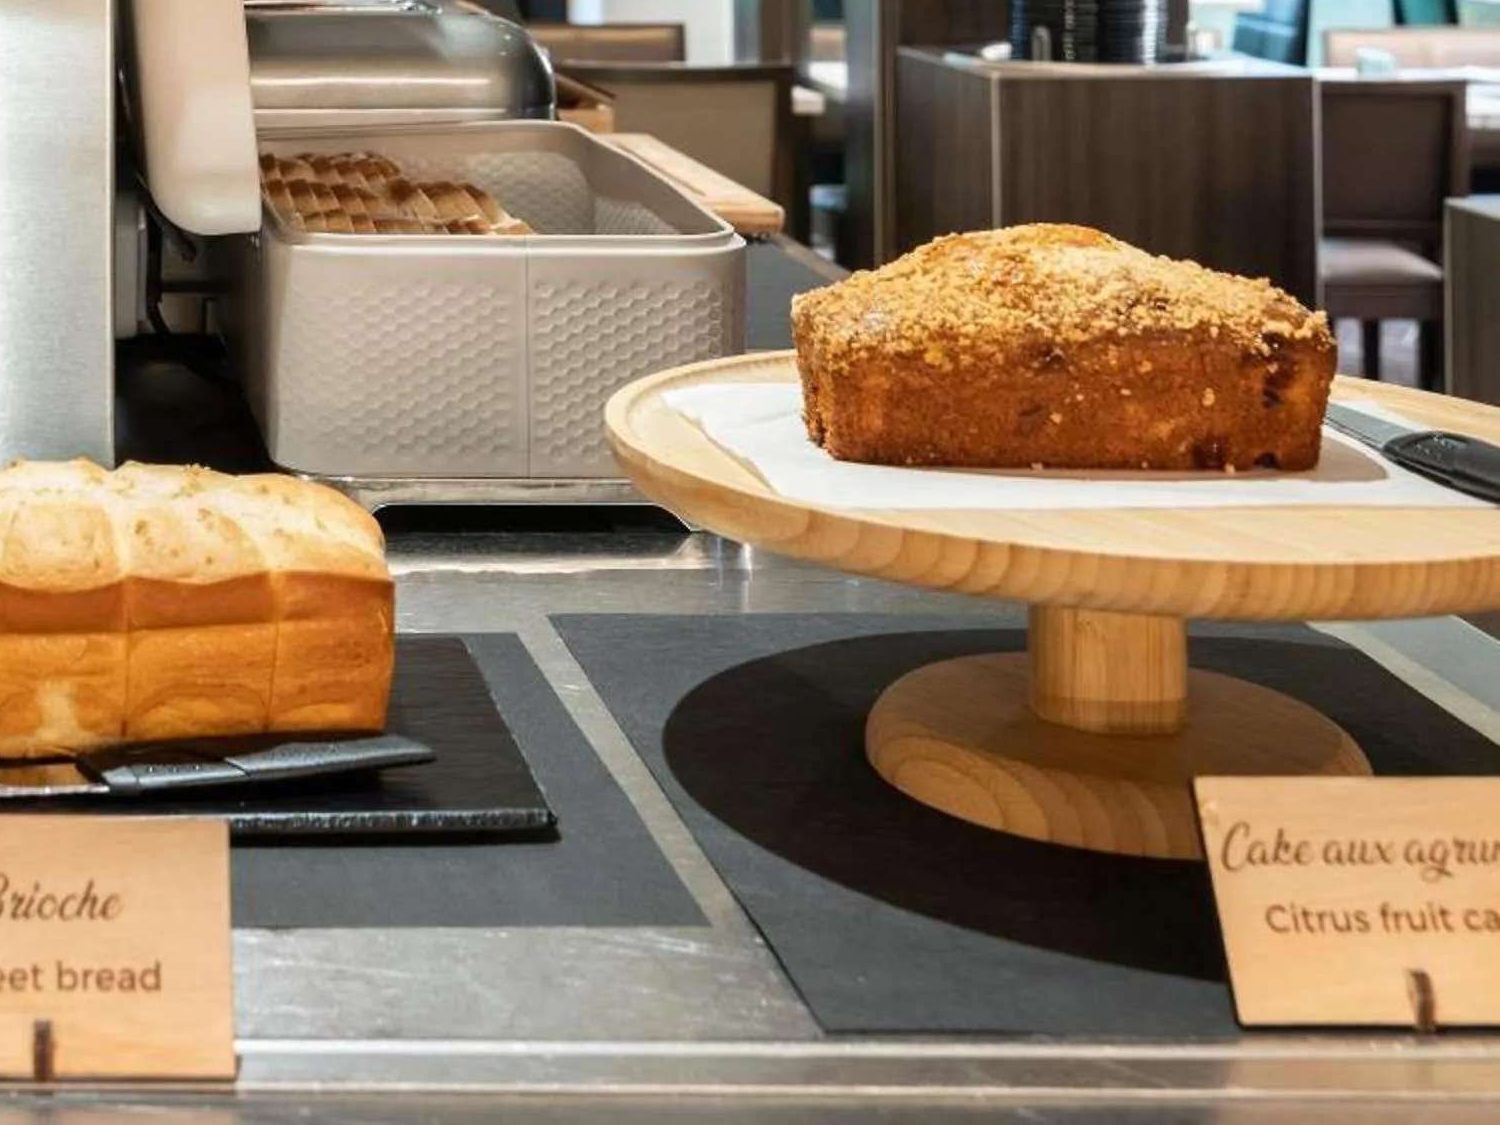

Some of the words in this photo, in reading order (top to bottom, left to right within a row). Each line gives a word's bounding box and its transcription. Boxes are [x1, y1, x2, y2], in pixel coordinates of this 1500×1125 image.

[1220, 821, 1313, 873] Cake
[1321, 838, 1394, 866] aux
[1264, 901, 1371, 935] Citrus
[1380, 901, 1454, 935] fruit
[56, 960, 163, 993] bread
